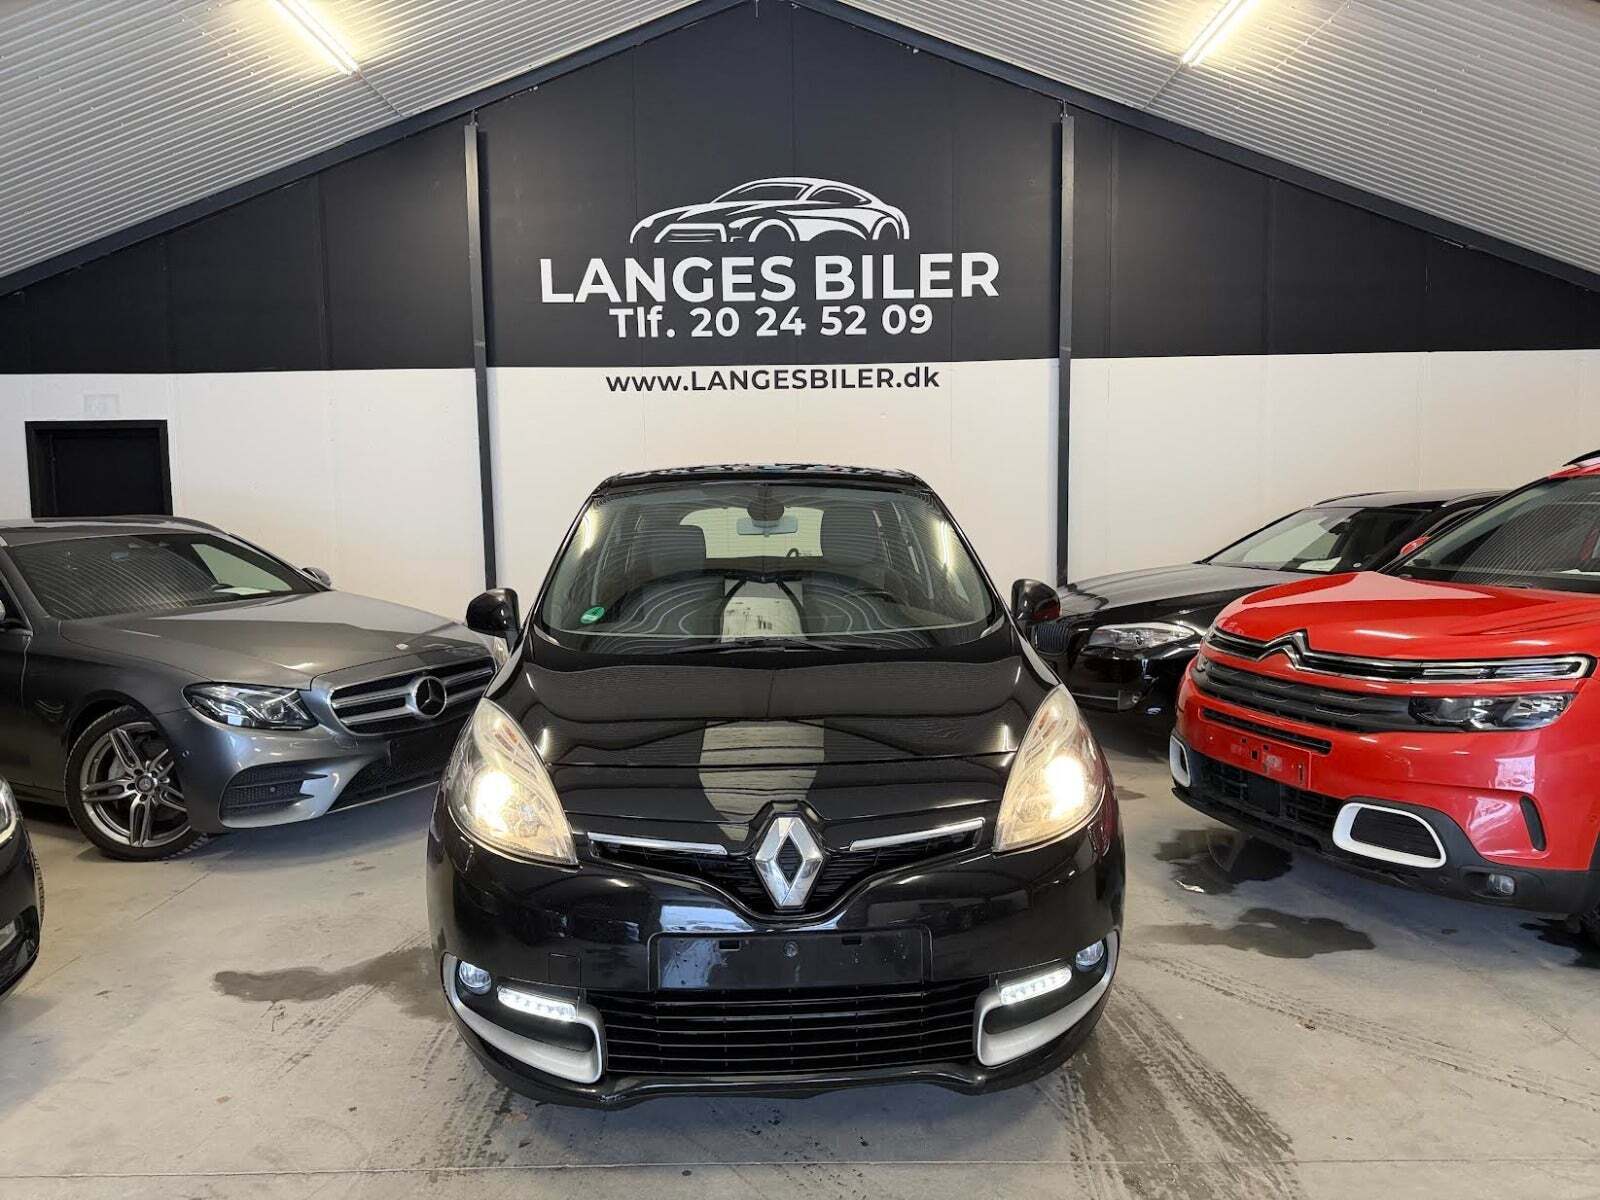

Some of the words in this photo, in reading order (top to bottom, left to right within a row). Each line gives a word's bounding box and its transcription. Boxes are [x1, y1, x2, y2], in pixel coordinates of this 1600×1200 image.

[540, 255, 797, 303] LANGES
[814, 252, 1000, 300] BILER
[609, 305, 676, 338] Tlf.
[690, 306, 740, 337] 20
[755, 306, 806, 337] 24
[820, 304, 867, 336] 52
[881, 303, 933, 335] 09
[605, 365, 940, 393] www.LANGESBILER.dk
